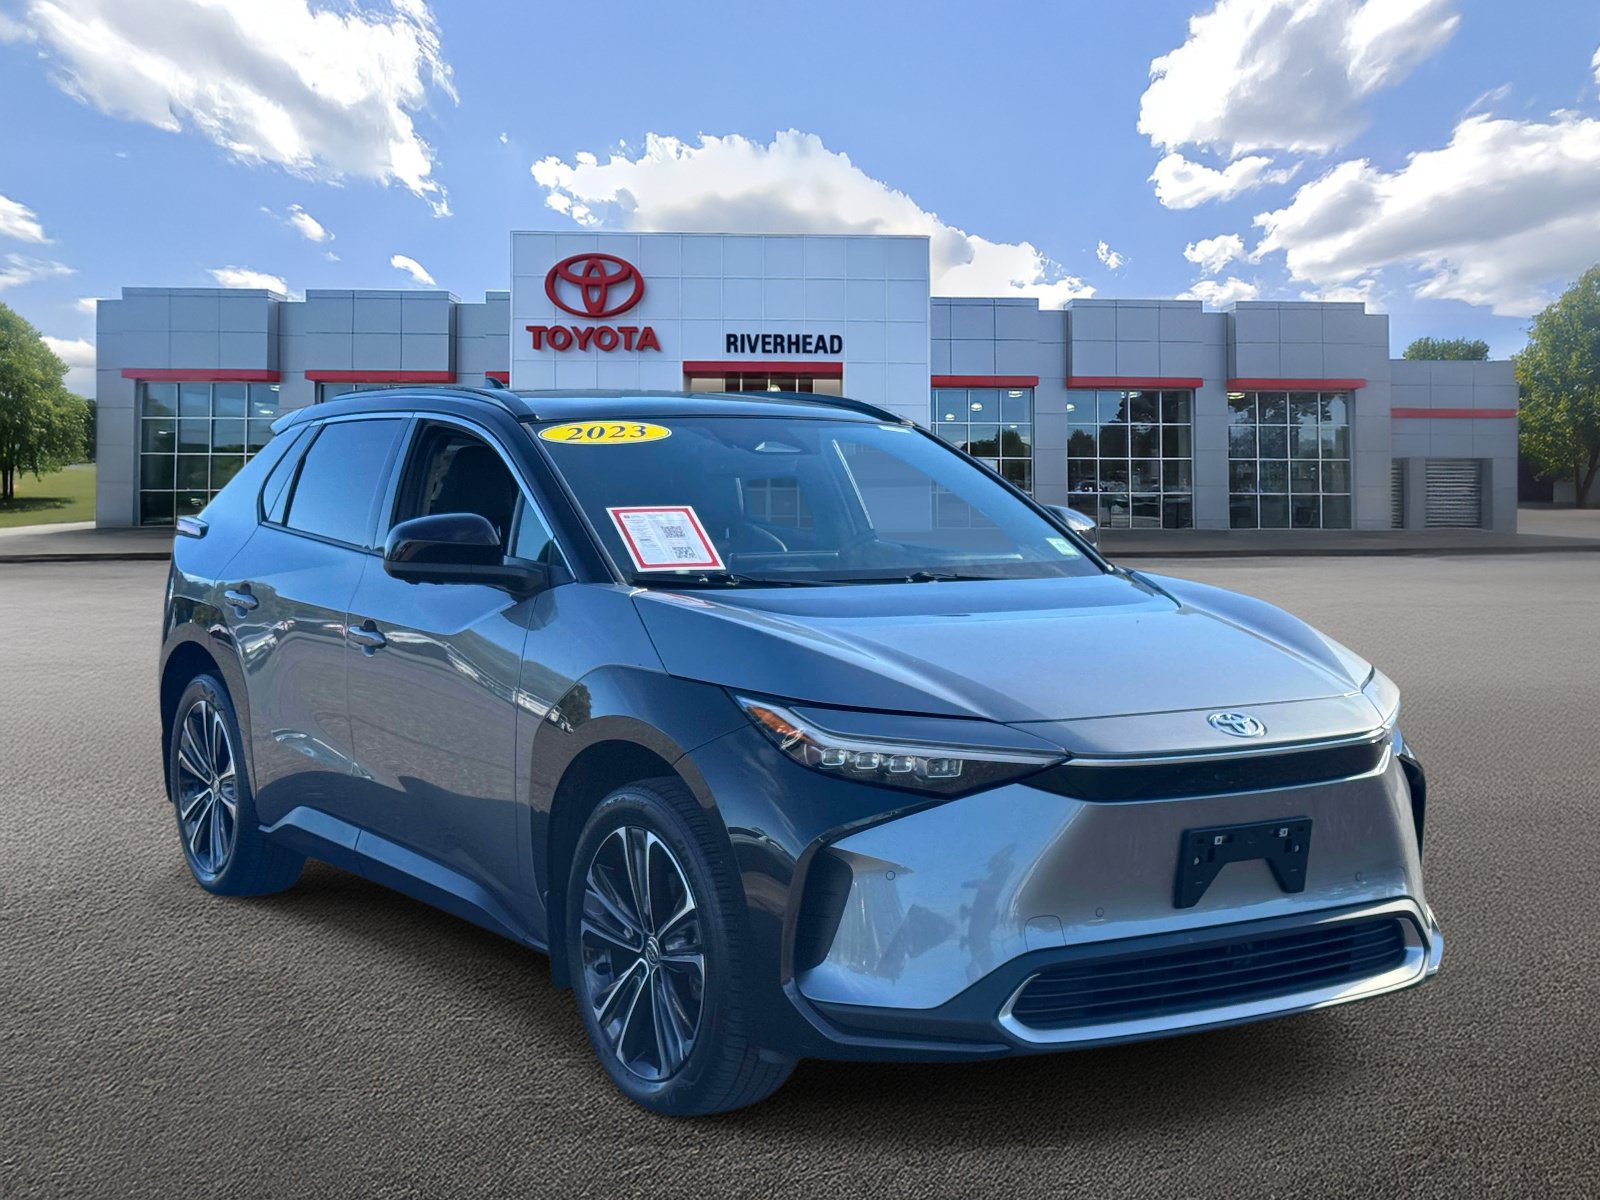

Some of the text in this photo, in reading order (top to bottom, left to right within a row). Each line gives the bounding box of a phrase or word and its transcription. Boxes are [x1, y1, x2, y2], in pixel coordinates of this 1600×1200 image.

[526, 326, 661, 352] TOYOTA
[726, 333, 843, 354] RIVERHEAD
[565, 425, 647, 441] 2023
